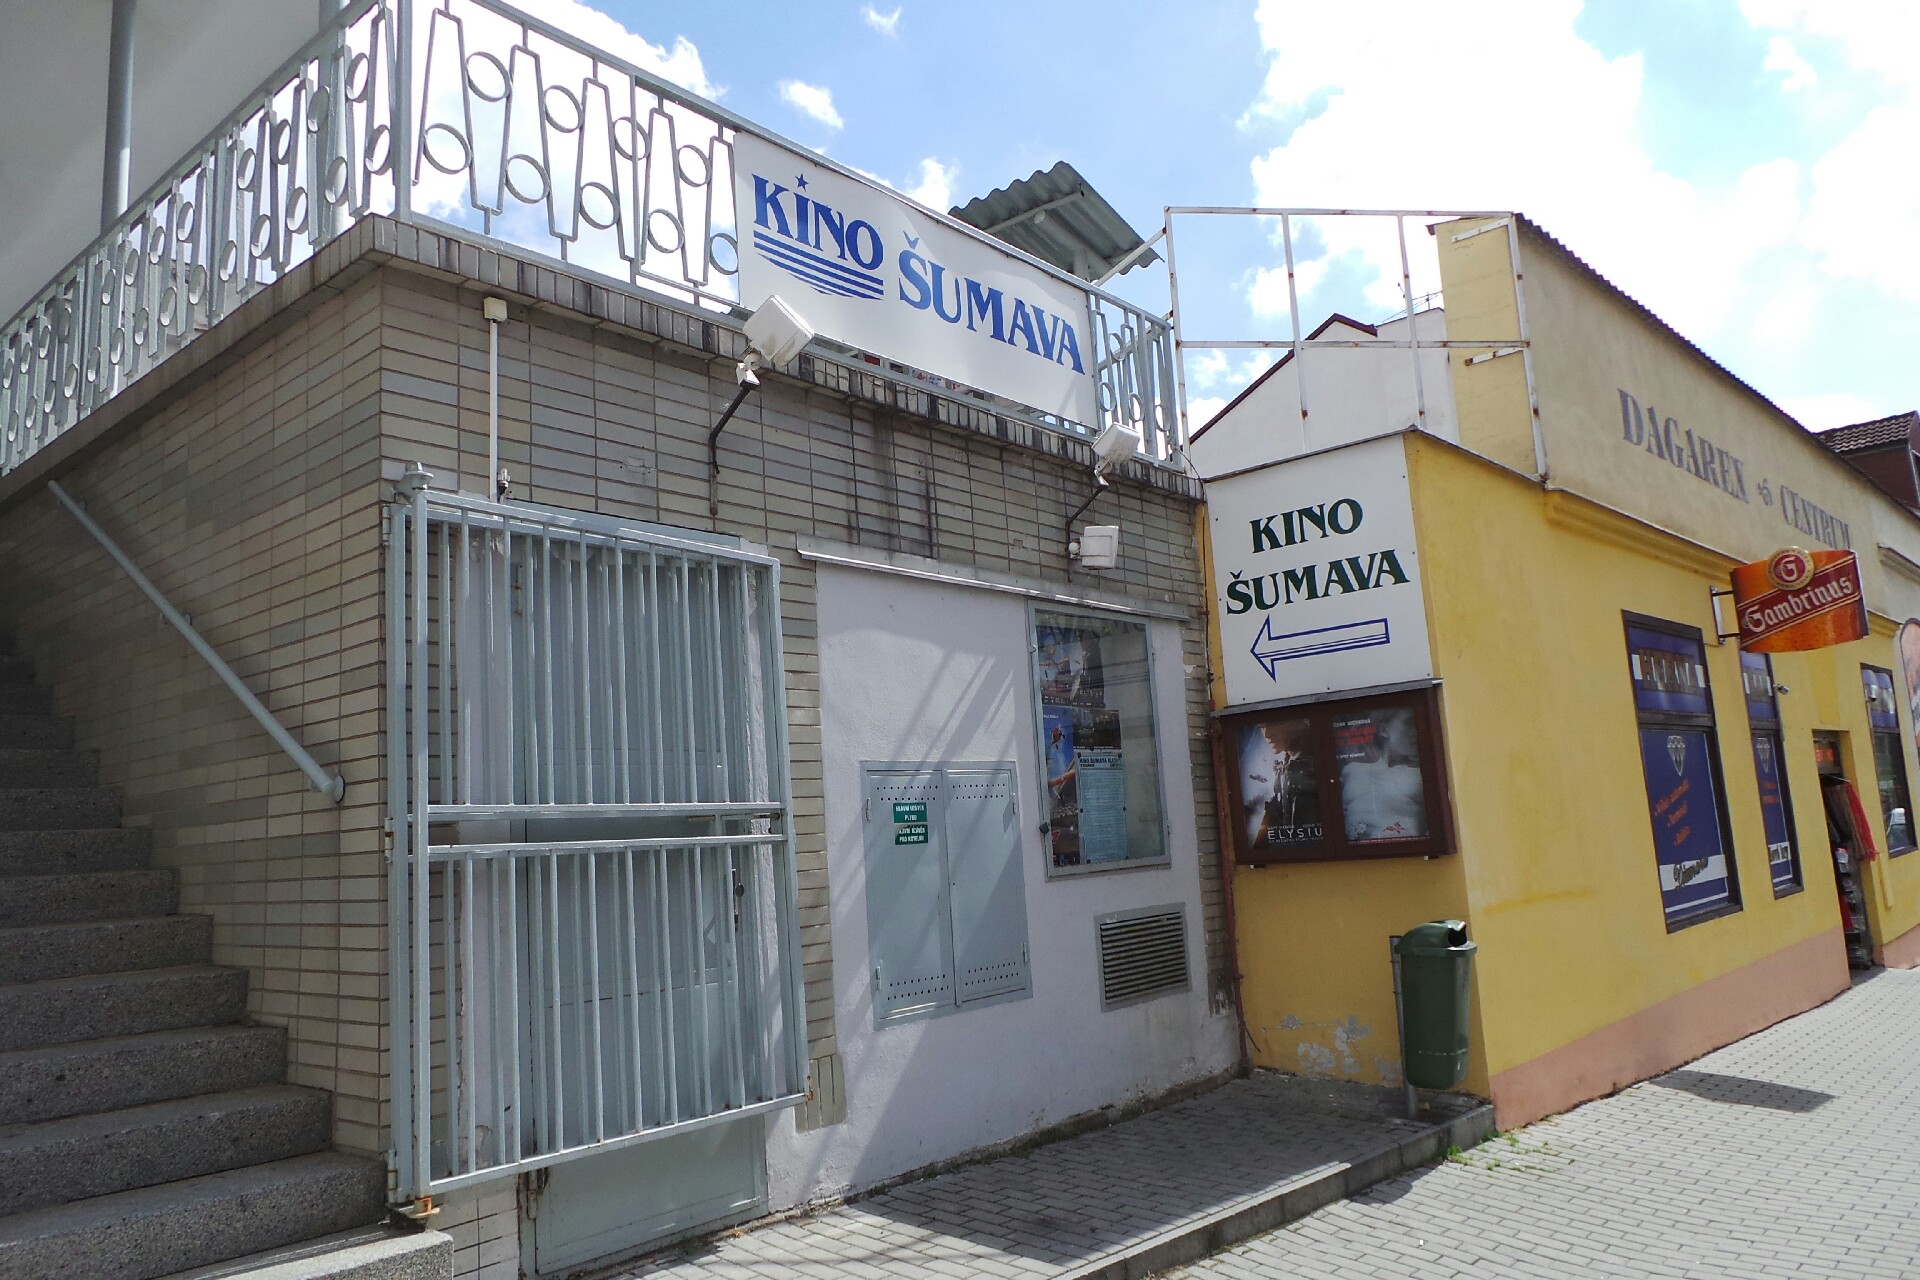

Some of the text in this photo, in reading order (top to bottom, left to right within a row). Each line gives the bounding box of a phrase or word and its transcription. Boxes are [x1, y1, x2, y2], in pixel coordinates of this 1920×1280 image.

[752, 173, 1086, 375] KINO ŠUMAVA
[1617, 388, 1750, 504] DAGAREX
[1780, 485, 1851, 550] CENTRUM
[1249, 498, 1364, 553] KINO
[1226, 549, 1410, 615] ŠUMAVA
[1741, 576, 1854, 633] Gambrinus
